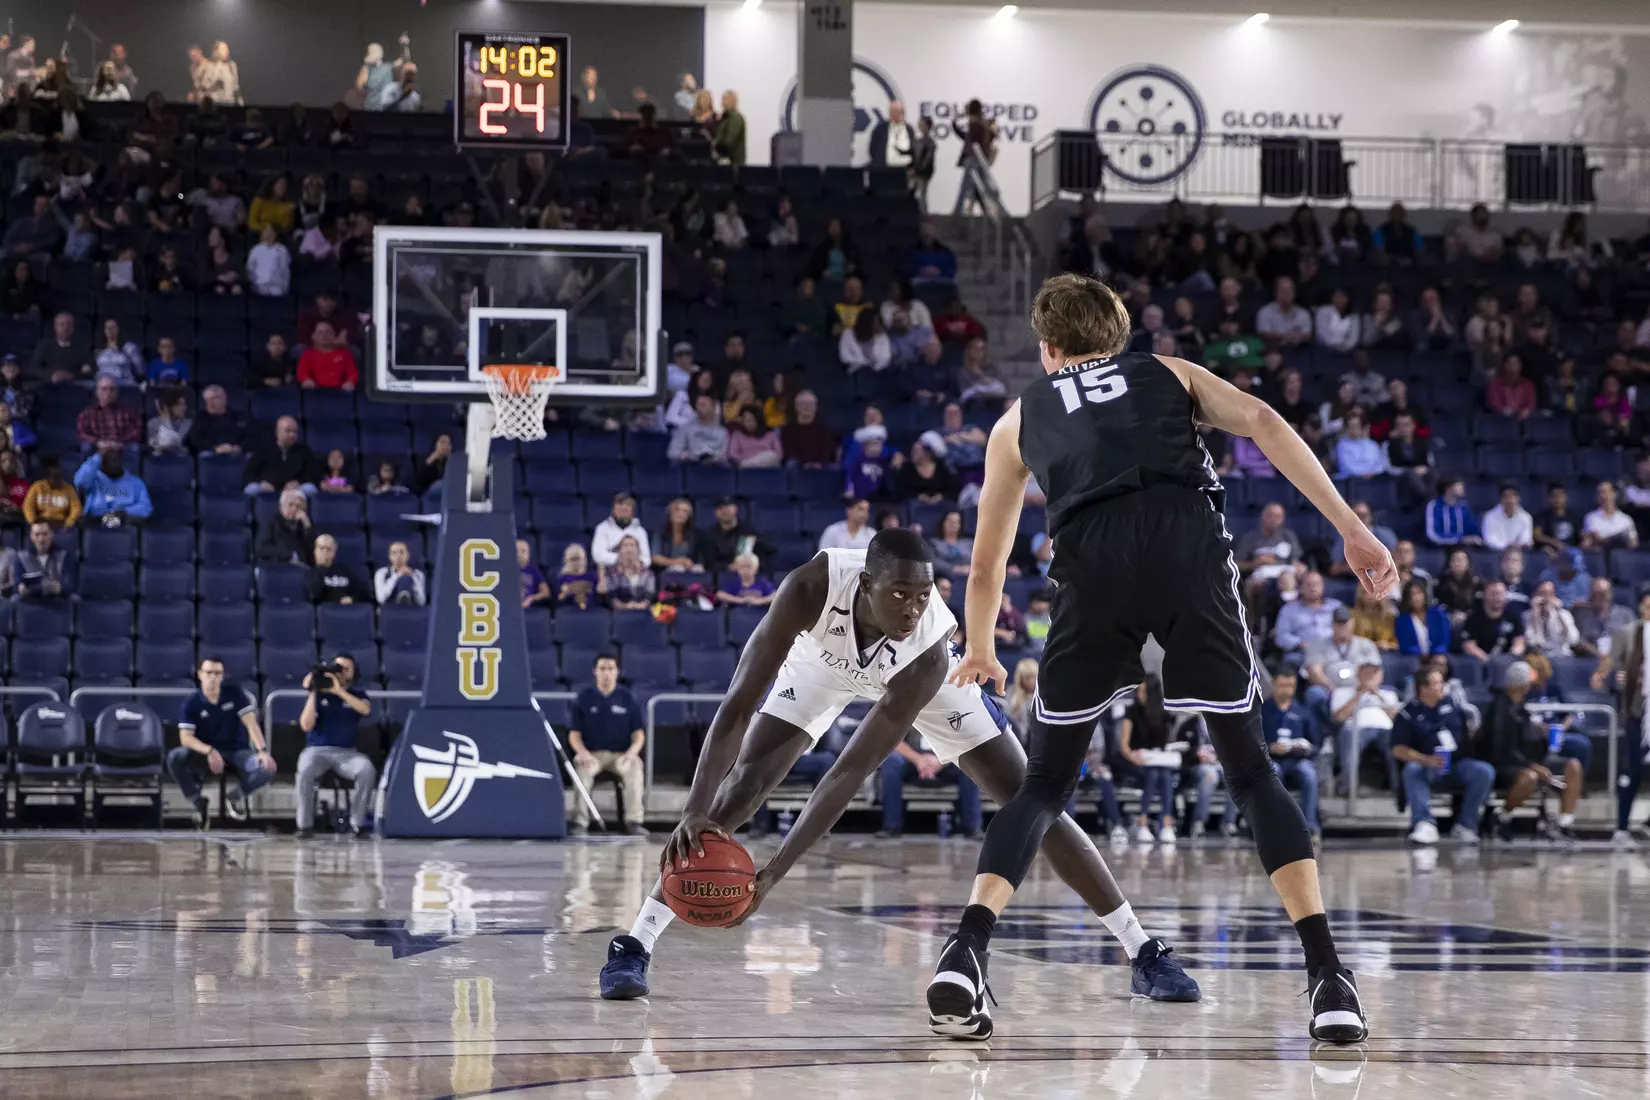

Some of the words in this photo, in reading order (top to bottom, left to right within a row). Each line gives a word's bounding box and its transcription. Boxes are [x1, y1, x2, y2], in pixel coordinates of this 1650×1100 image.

[480, 45, 557, 78] 14:02
[479, 79, 545, 135] 24
[1222, 110, 1343, 129] GLOBALLY
[1052, 363, 1129, 415] 15
[456, 538, 502, 700] CBU
[680, 879, 742, 898] Wilson
